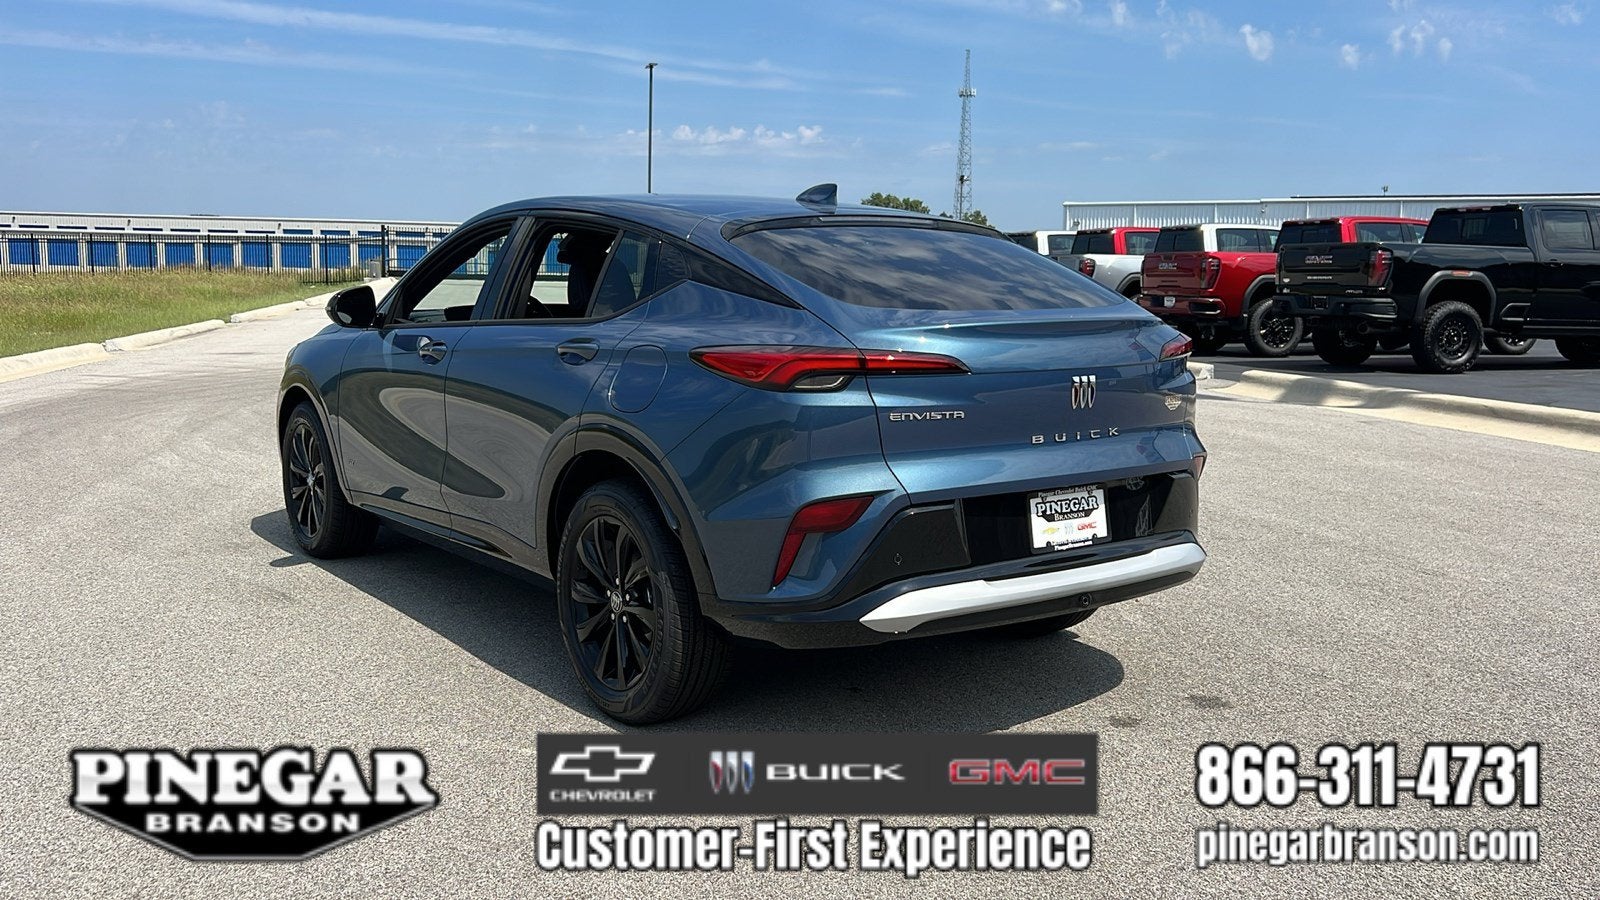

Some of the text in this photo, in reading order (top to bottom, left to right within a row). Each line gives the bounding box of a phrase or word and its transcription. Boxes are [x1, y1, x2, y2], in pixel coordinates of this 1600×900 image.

[889, 411, 965, 421] ENVISTA
[1031, 427, 1119, 444] BUICK
[1036, 496, 1099, 516] PINEGAR
[1077, 521, 1097, 531] GMC
